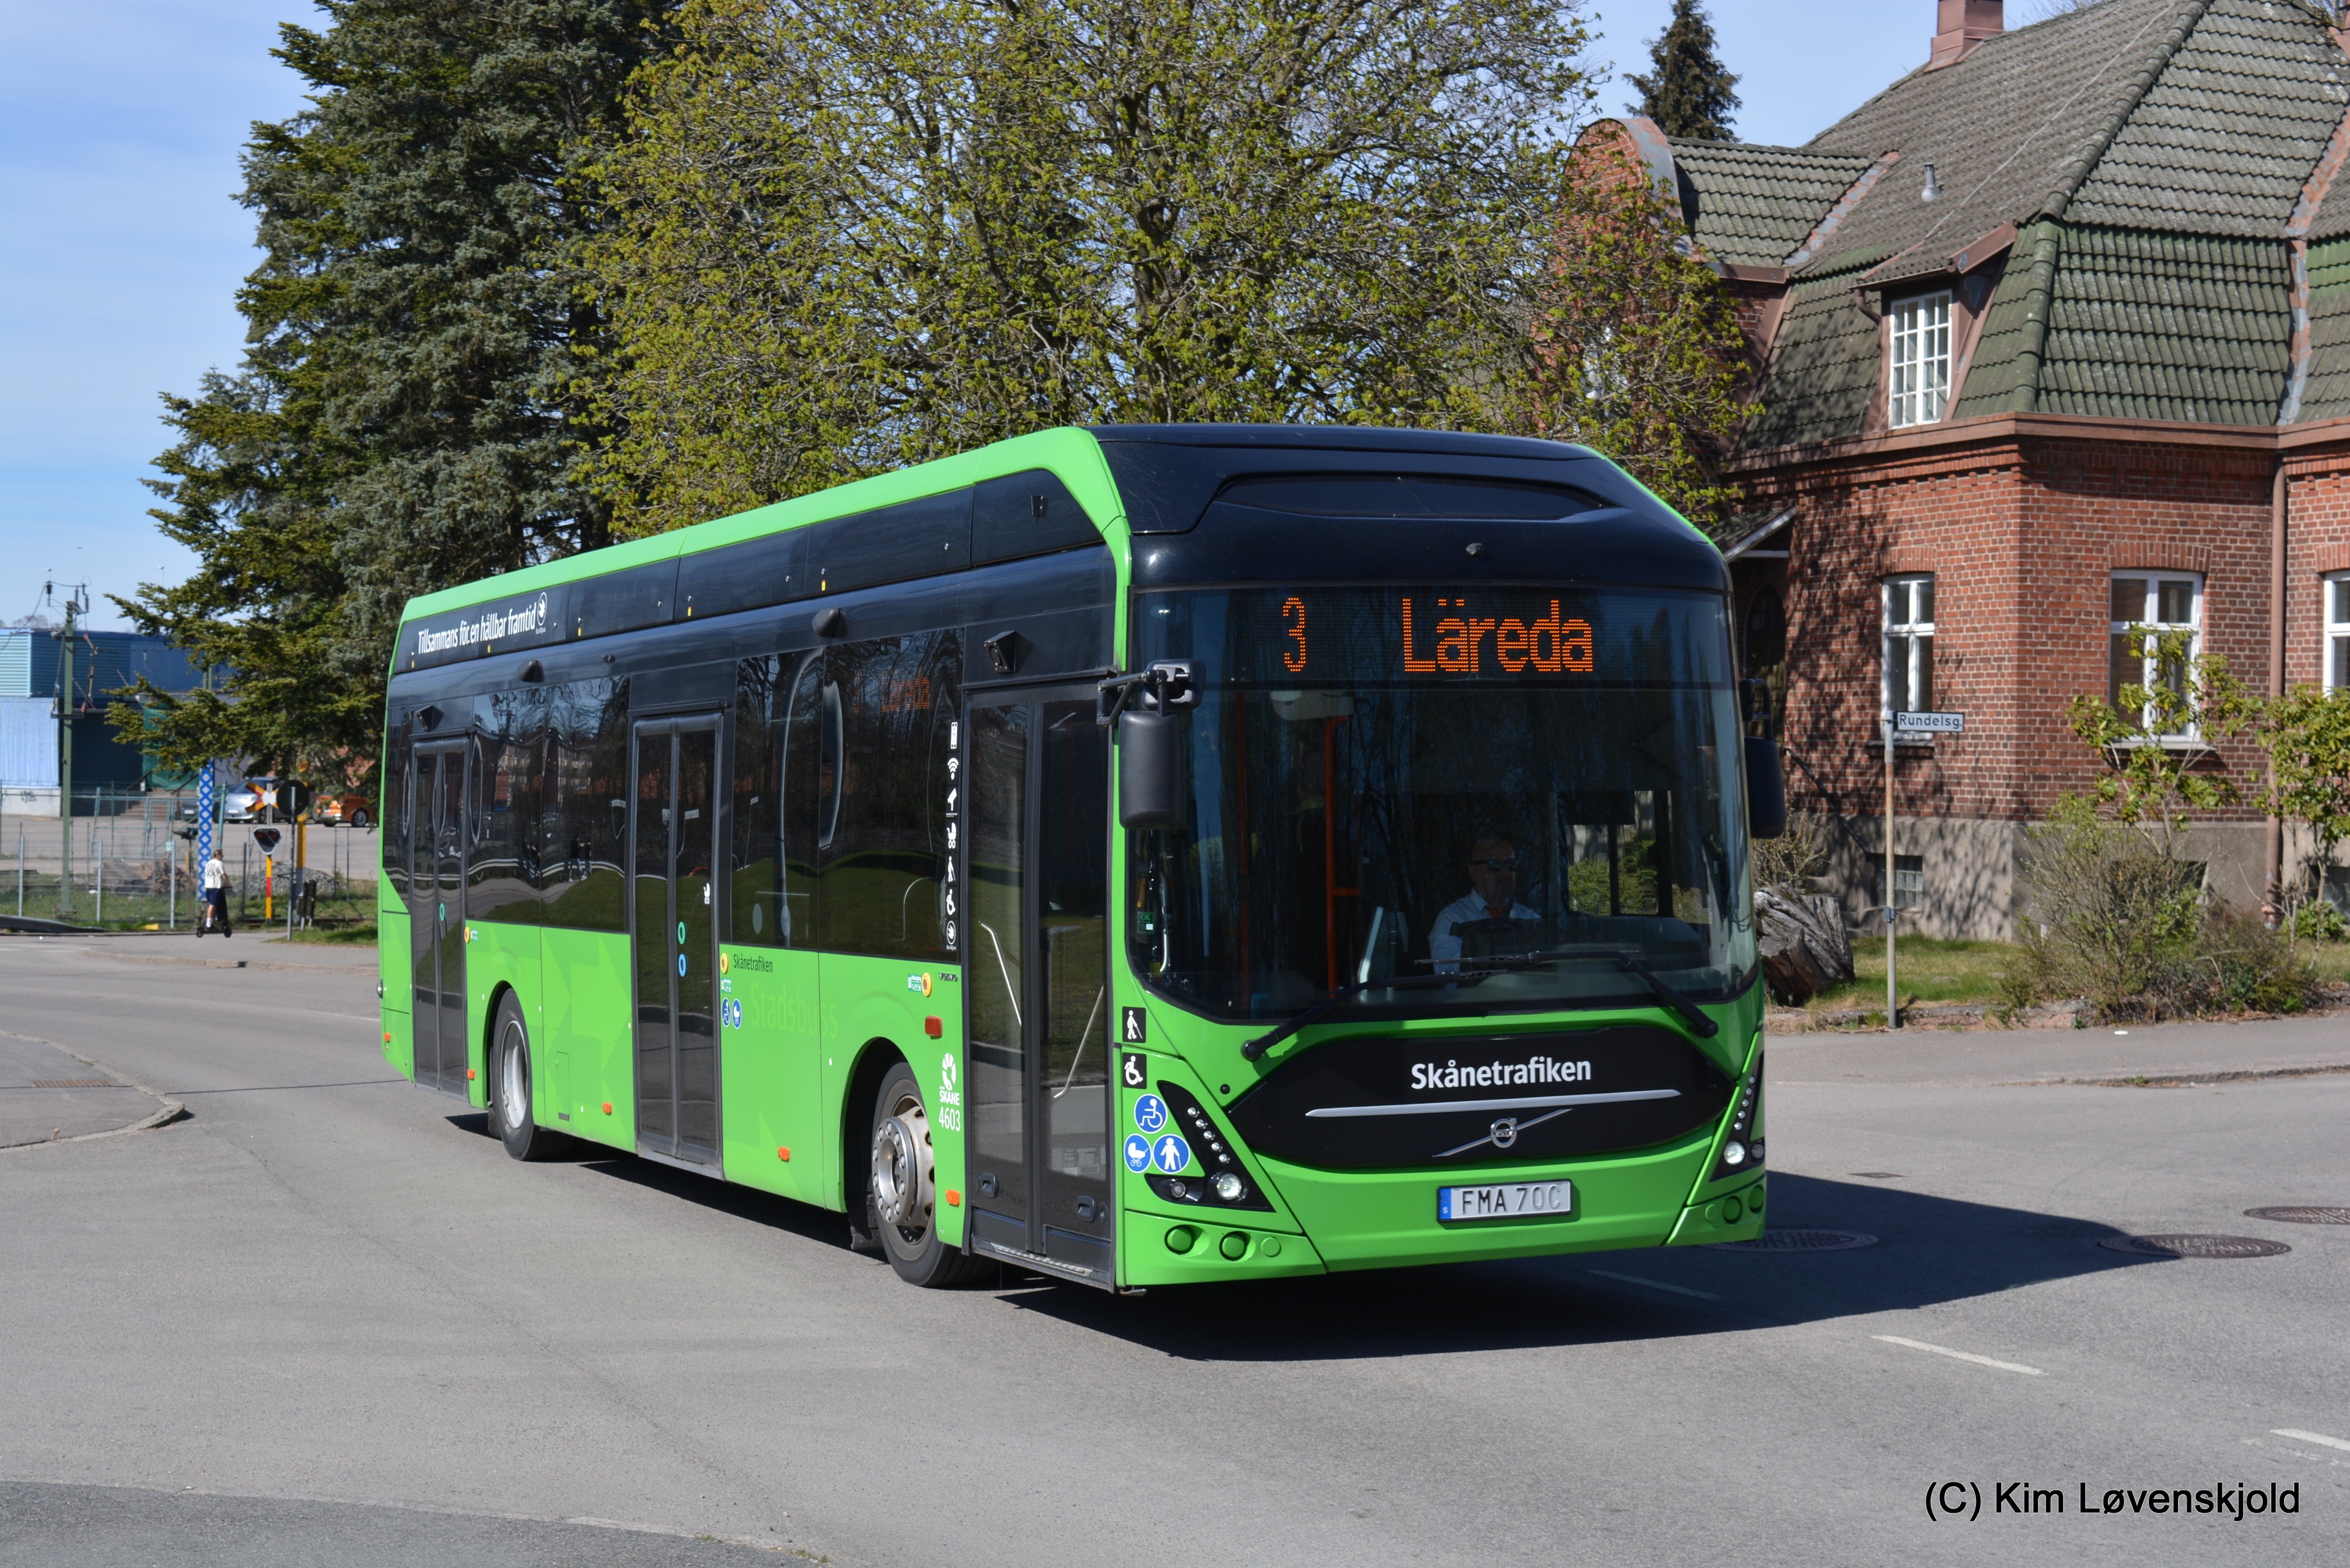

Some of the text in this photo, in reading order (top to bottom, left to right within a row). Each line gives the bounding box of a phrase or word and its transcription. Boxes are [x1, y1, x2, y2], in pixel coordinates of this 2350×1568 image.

[418, 602, 537, 654] Tillsammans för en hållbar framtid
[1283, 597, 1593, 672] 3 Läreda
[1900, 714, 1962, 729] Rundelsg.
[733, 953, 774, 973] Skånetrafiken
[750, 982, 838, 1039] Stadsbuss
[1411, 1056, 1592, 1089] Skånetrafiken
[939, 1106, 961, 1132] 4603
[1461, 1184, 1561, 1215] FMA 70C
